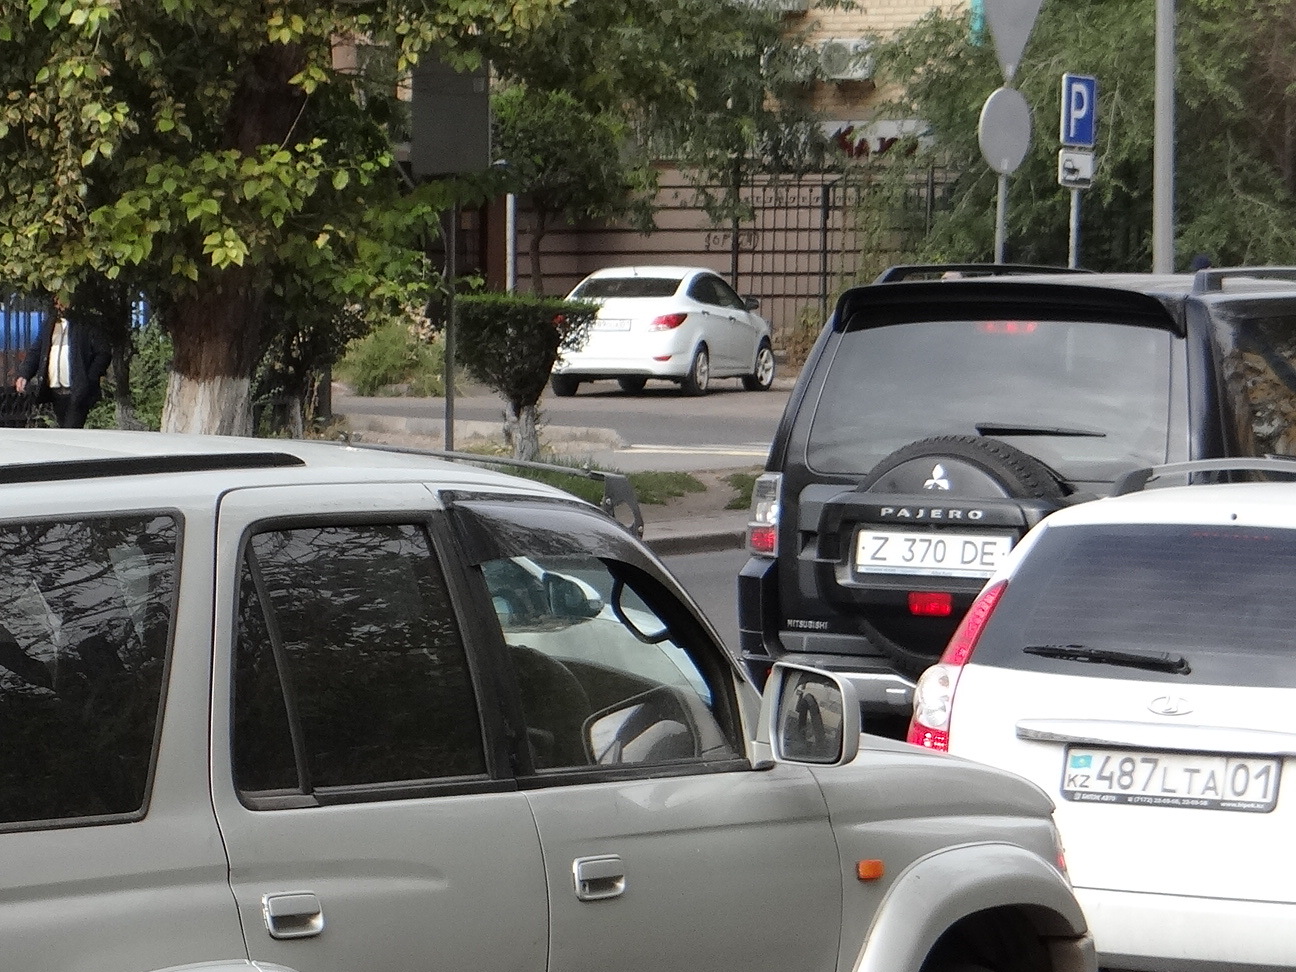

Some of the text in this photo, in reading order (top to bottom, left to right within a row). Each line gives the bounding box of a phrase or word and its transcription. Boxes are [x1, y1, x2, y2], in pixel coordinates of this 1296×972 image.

[1070, 82, 1088, 138] P
[880, 507, 983, 520] PAJERO
[870, 536, 998, 566] Z 370 DE
[1066, 774, 1091, 789] KZ
[1231, 763, 1272, 799] 01
